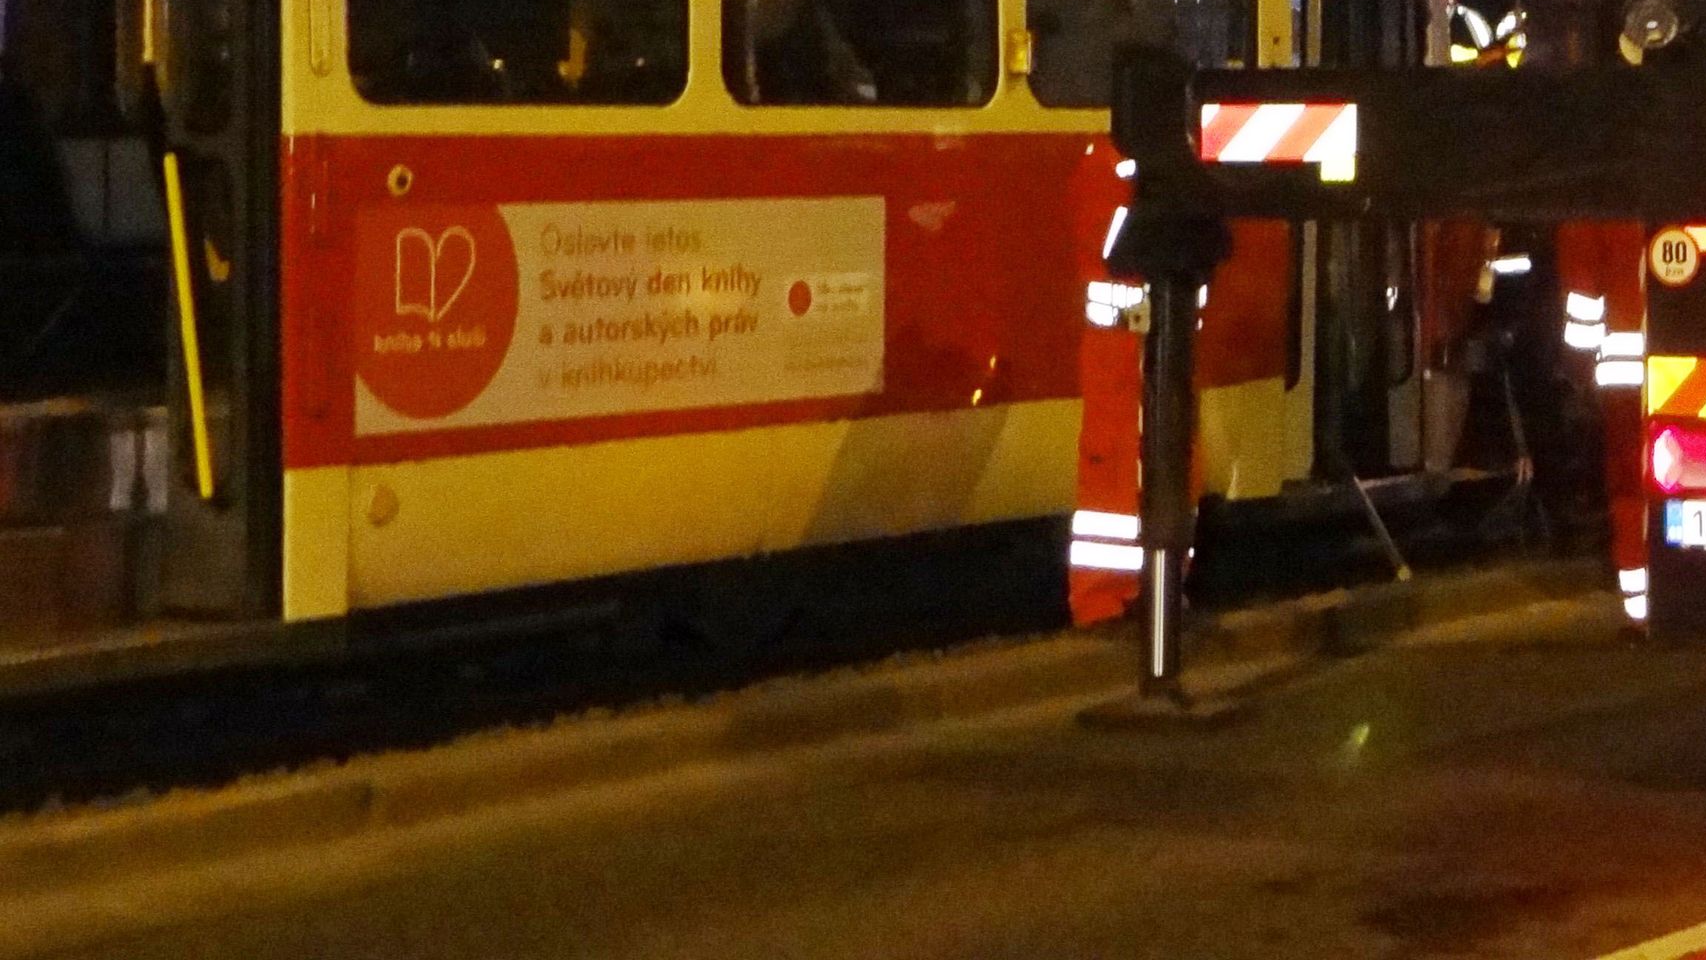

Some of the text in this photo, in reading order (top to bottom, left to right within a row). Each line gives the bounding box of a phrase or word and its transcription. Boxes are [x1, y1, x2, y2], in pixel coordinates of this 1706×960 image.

[1662, 239, 1687, 265] 80
[647, 264, 691, 296] den
[701, 261, 763, 297] knihy
[538, 324, 553, 345] a
